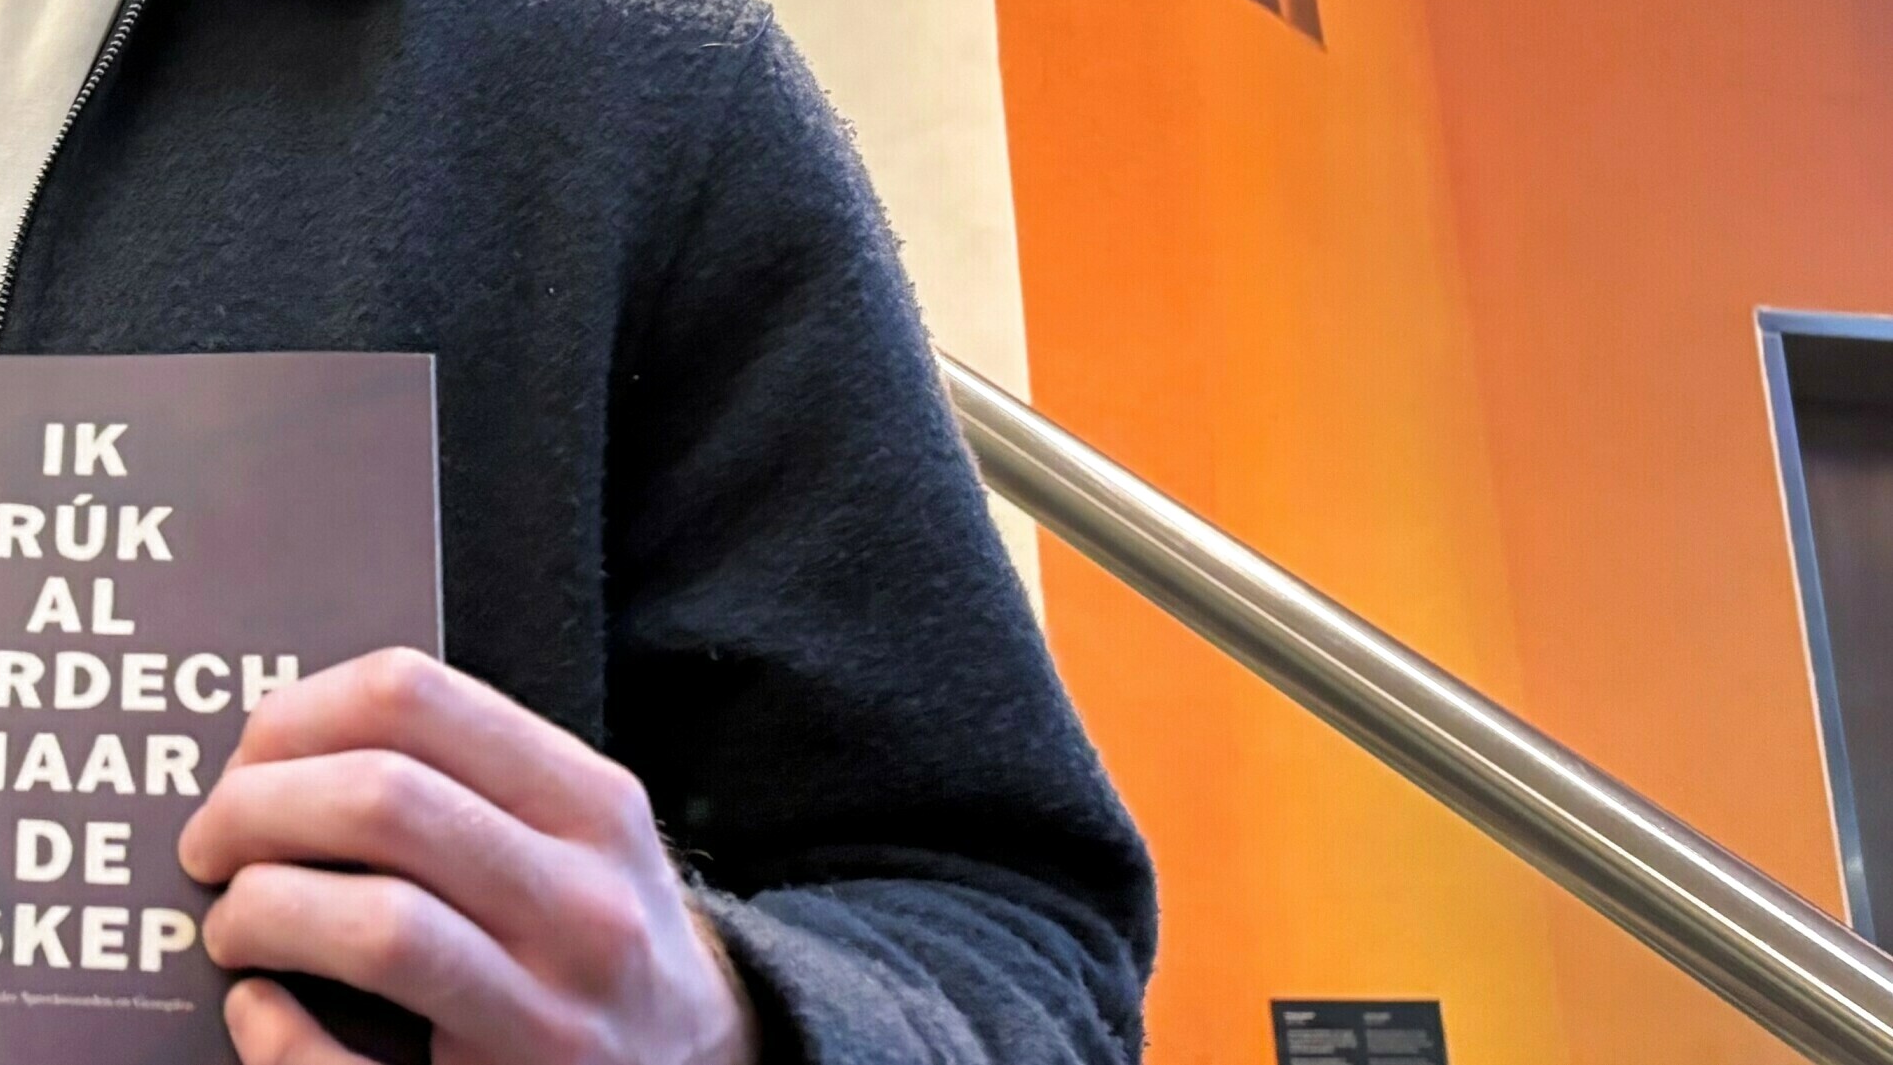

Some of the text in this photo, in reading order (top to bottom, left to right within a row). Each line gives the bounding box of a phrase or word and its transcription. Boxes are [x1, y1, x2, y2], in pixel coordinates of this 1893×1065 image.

[42, 422, 129, 478] IK
[25, 576, 136, 636] AL
[14, 818, 132, 885] DE
